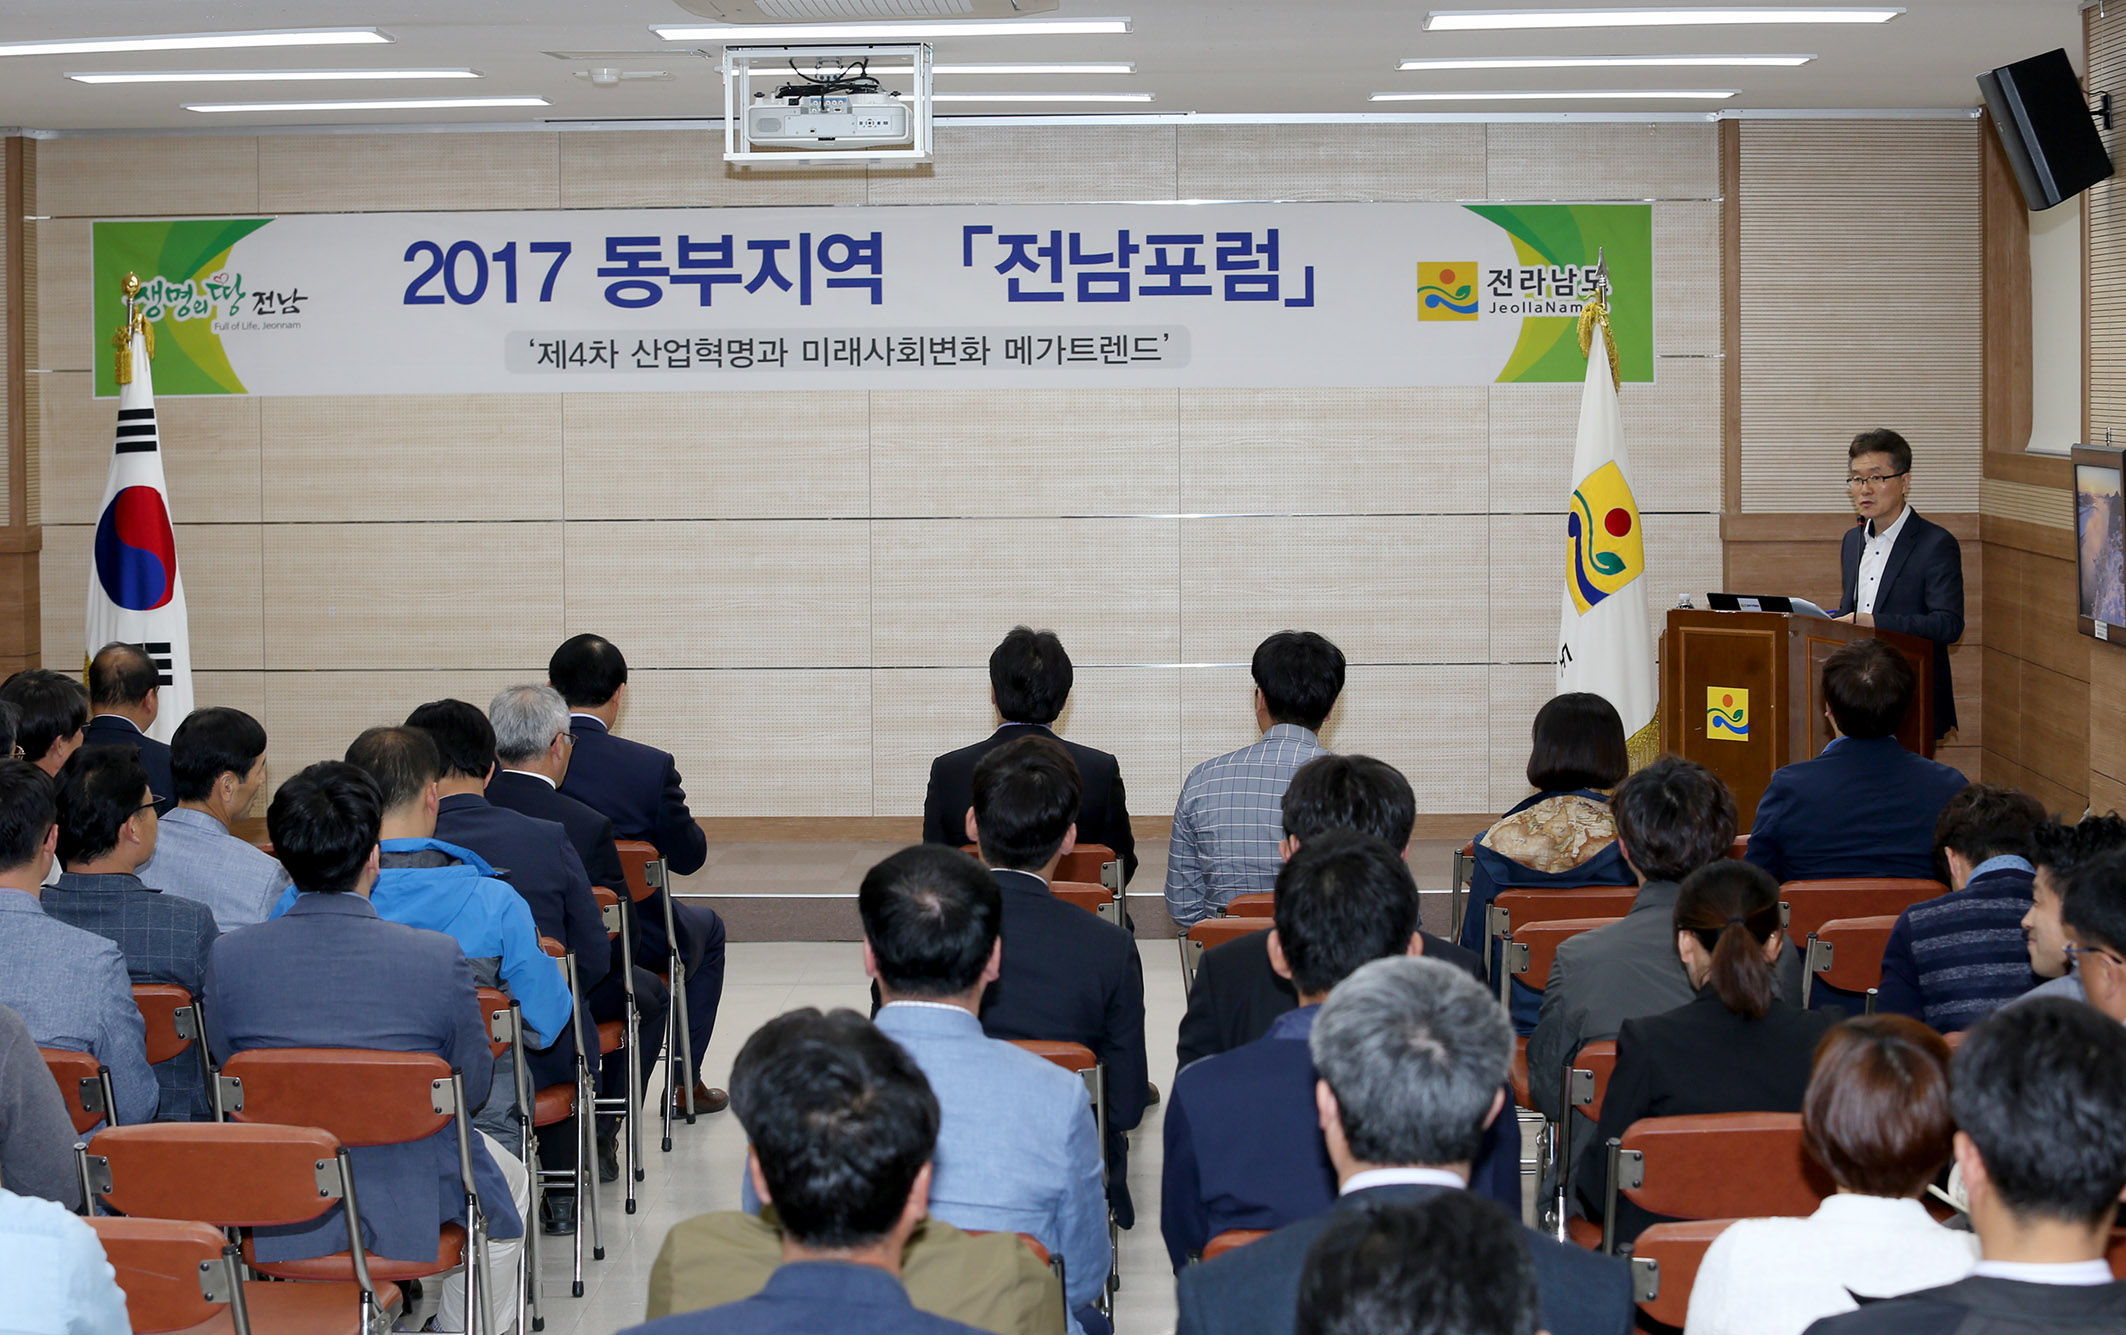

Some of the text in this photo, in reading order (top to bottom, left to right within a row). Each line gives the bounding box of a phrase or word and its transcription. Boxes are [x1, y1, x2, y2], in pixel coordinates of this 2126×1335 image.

[403, 224, 1316, 309] 2017 동부지역 「전남포럼」
[205, 272, 247, 317] 땅
[251, 287, 309, 316] 전남
[1488, 301, 1584, 314] JeollaNam
[214, 321, 230, 331] Full
[231, 321, 240, 331] of
[262, 321, 302, 330] Jeonnam
[630, 337, 789, 369] 산업혁명과
[801, 335, 991, 368] 미래사회변화
